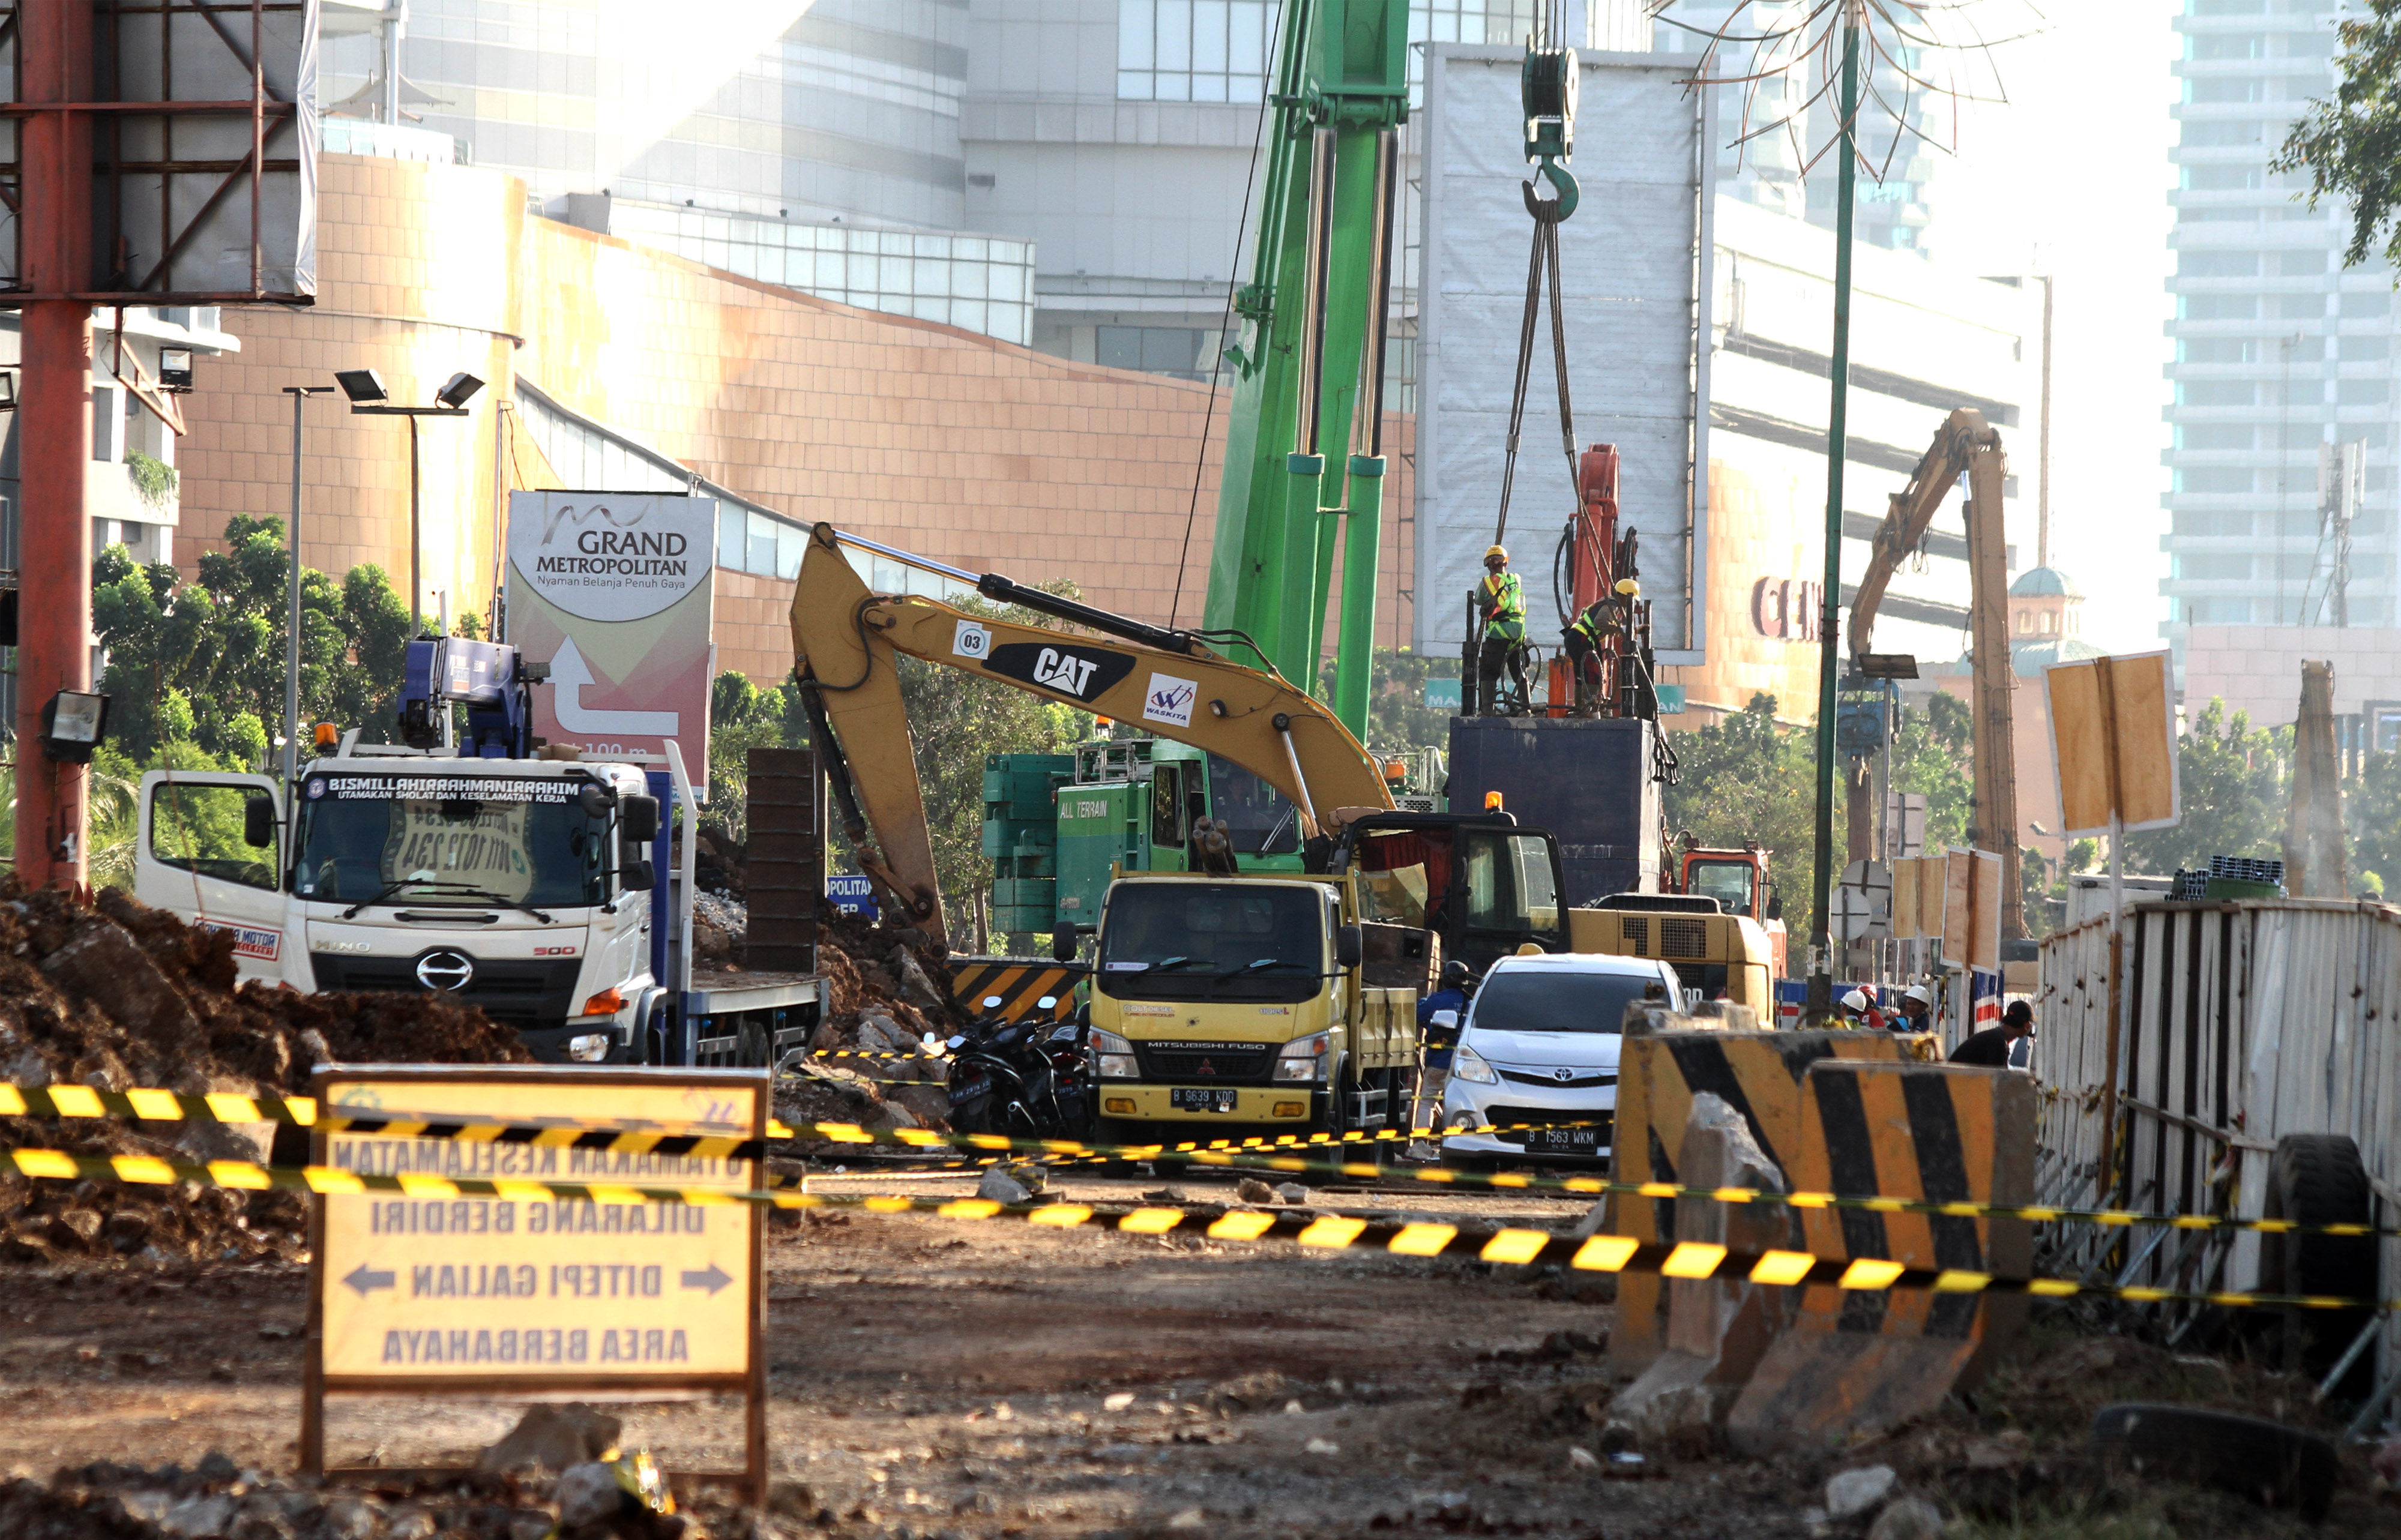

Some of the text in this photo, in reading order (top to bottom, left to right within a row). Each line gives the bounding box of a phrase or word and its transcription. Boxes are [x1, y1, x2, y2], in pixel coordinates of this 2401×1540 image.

[577, 530, 687, 556] GRAND
[536, 557, 687, 576] METROPOLITAN
[538, 576, 685, 590] Nyaman Belanja Penuh Gaya
[964, 634, 980, 649] 03
[1033, 648, 1098, 696] CAT
[1146, 706, 1187, 721] WASKITA
[328, 778, 579, 796] BISMILLAHIRRAHMANIRRAHIM
[338, 791, 392, 800] UTAMAKAN
[396, 792, 434, 800] SHOLAT
[460, 793, 532, 802] KESELAMATAN
[535, 795, 567, 804] KERJA
[1060, 800, 1107, 819] ALL TERRAIN
[241, 931, 276, 947] MOTOR
[314, 940, 372, 952] HINO
[533, 946, 576, 955] 500
[1173, 1090, 1179, 1101] B
[1185, 1090, 1209, 1102] 9639
[1529, 1131, 1535, 1142] B
[1574, 1132, 1594, 1144] WKM
